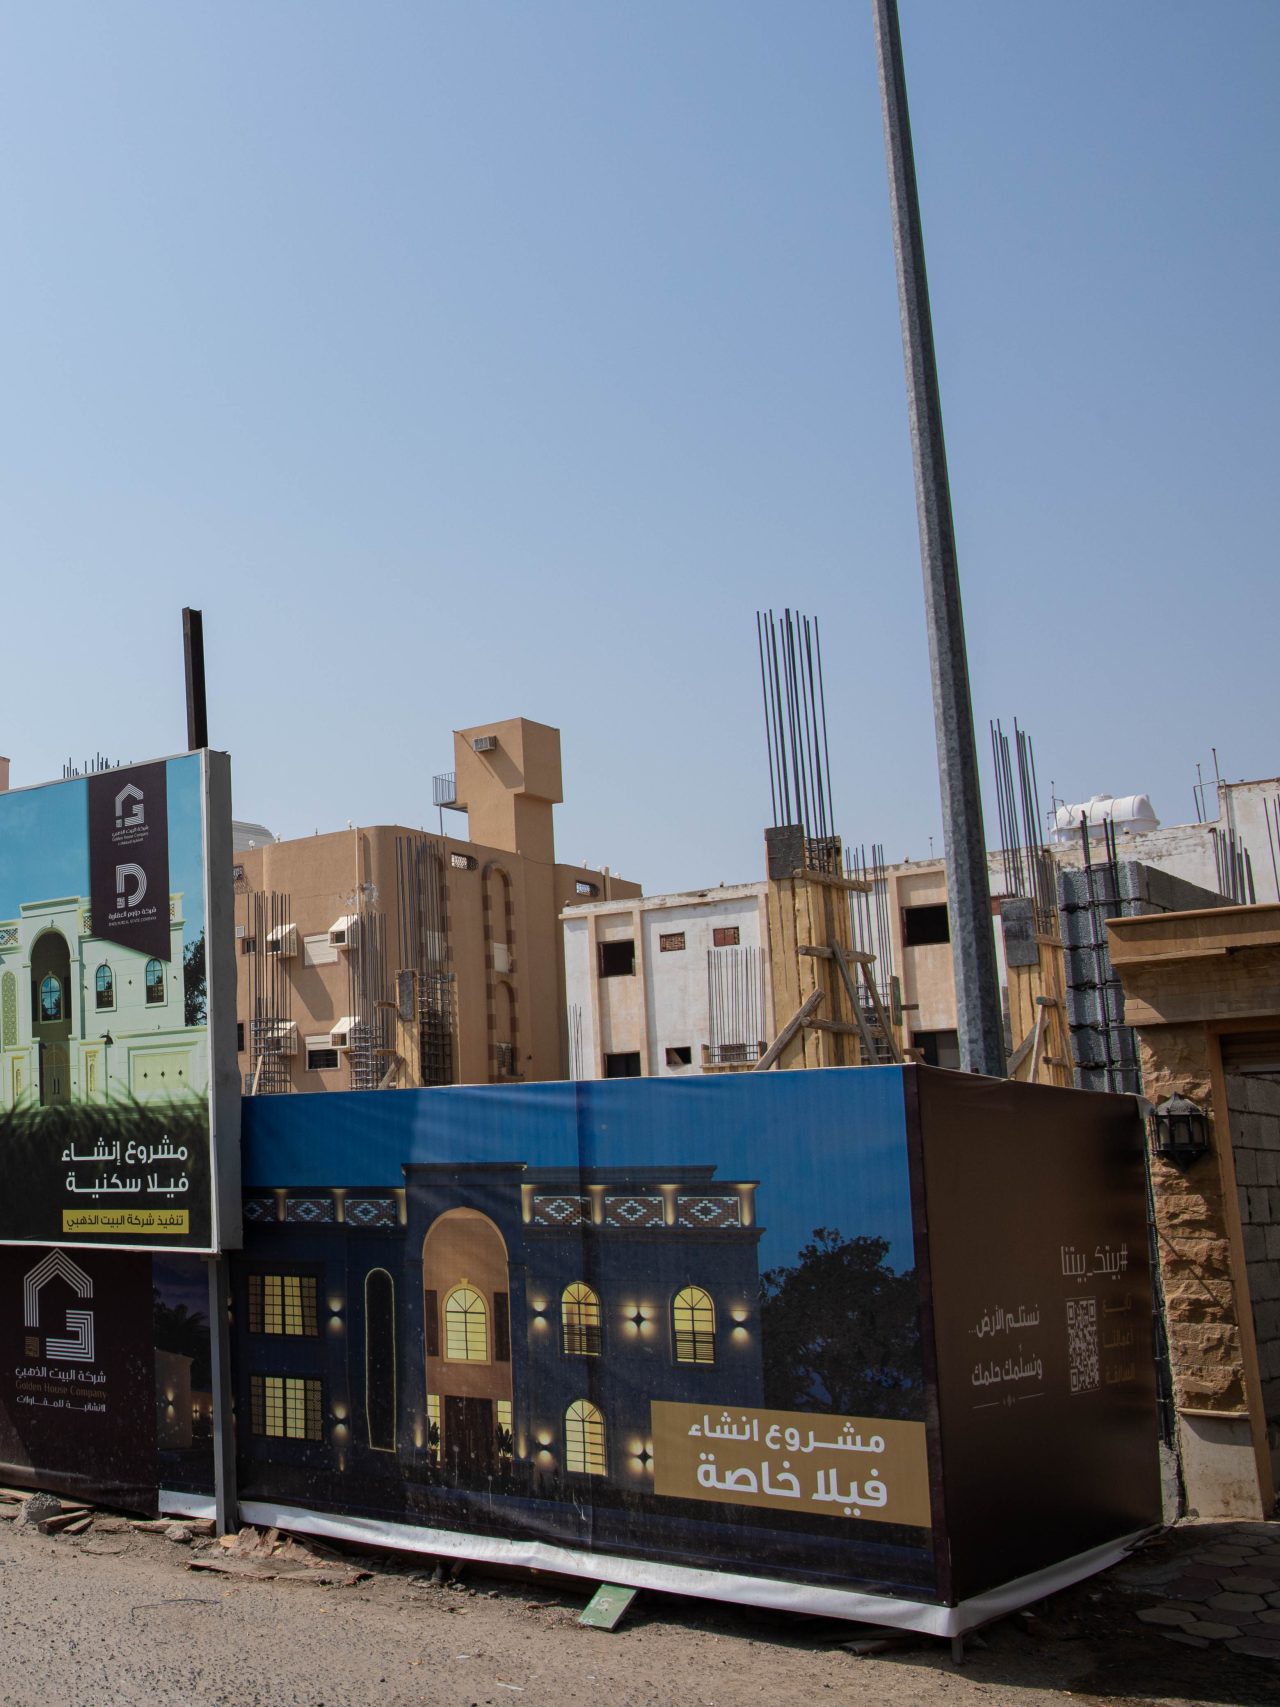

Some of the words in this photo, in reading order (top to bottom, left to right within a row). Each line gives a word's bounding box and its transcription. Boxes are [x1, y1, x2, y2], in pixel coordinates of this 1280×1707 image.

[61, 1137, 120, 1166] إنشاء
[124, 1134, 188, 1165] مشروع
[65, 1171, 141, 1199] سكنية
[147, 1172, 189, 1199] فيلا
[66, 1213, 99, 1228] الذهبي
[100, 1214, 125, 1228] البيت
[126, 1213, 155, 1227] شركة
[156, 1213, 184, 1229] تنفيذ
[1006, 1303, 1041, 1335] نستلم
[15, 1365, 47, 1379] الذهبي
[49, 1367, 76, 1382] البيت
[77, 1370, 106, 1385] شركة
[971, 1360, 1002, 1386] حلمك
[15, 1380, 42, 1391] Golden
[44, 1383, 68, 1395] House
[70, 1385, 107, 1399] Company
[687, 1411, 759, 1442] انشاء
[765, 1421, 886, 1453] مشروع
[696, 1451, 801, 1498] خاصة
[811, 1468, 888, 1517] فيلا
